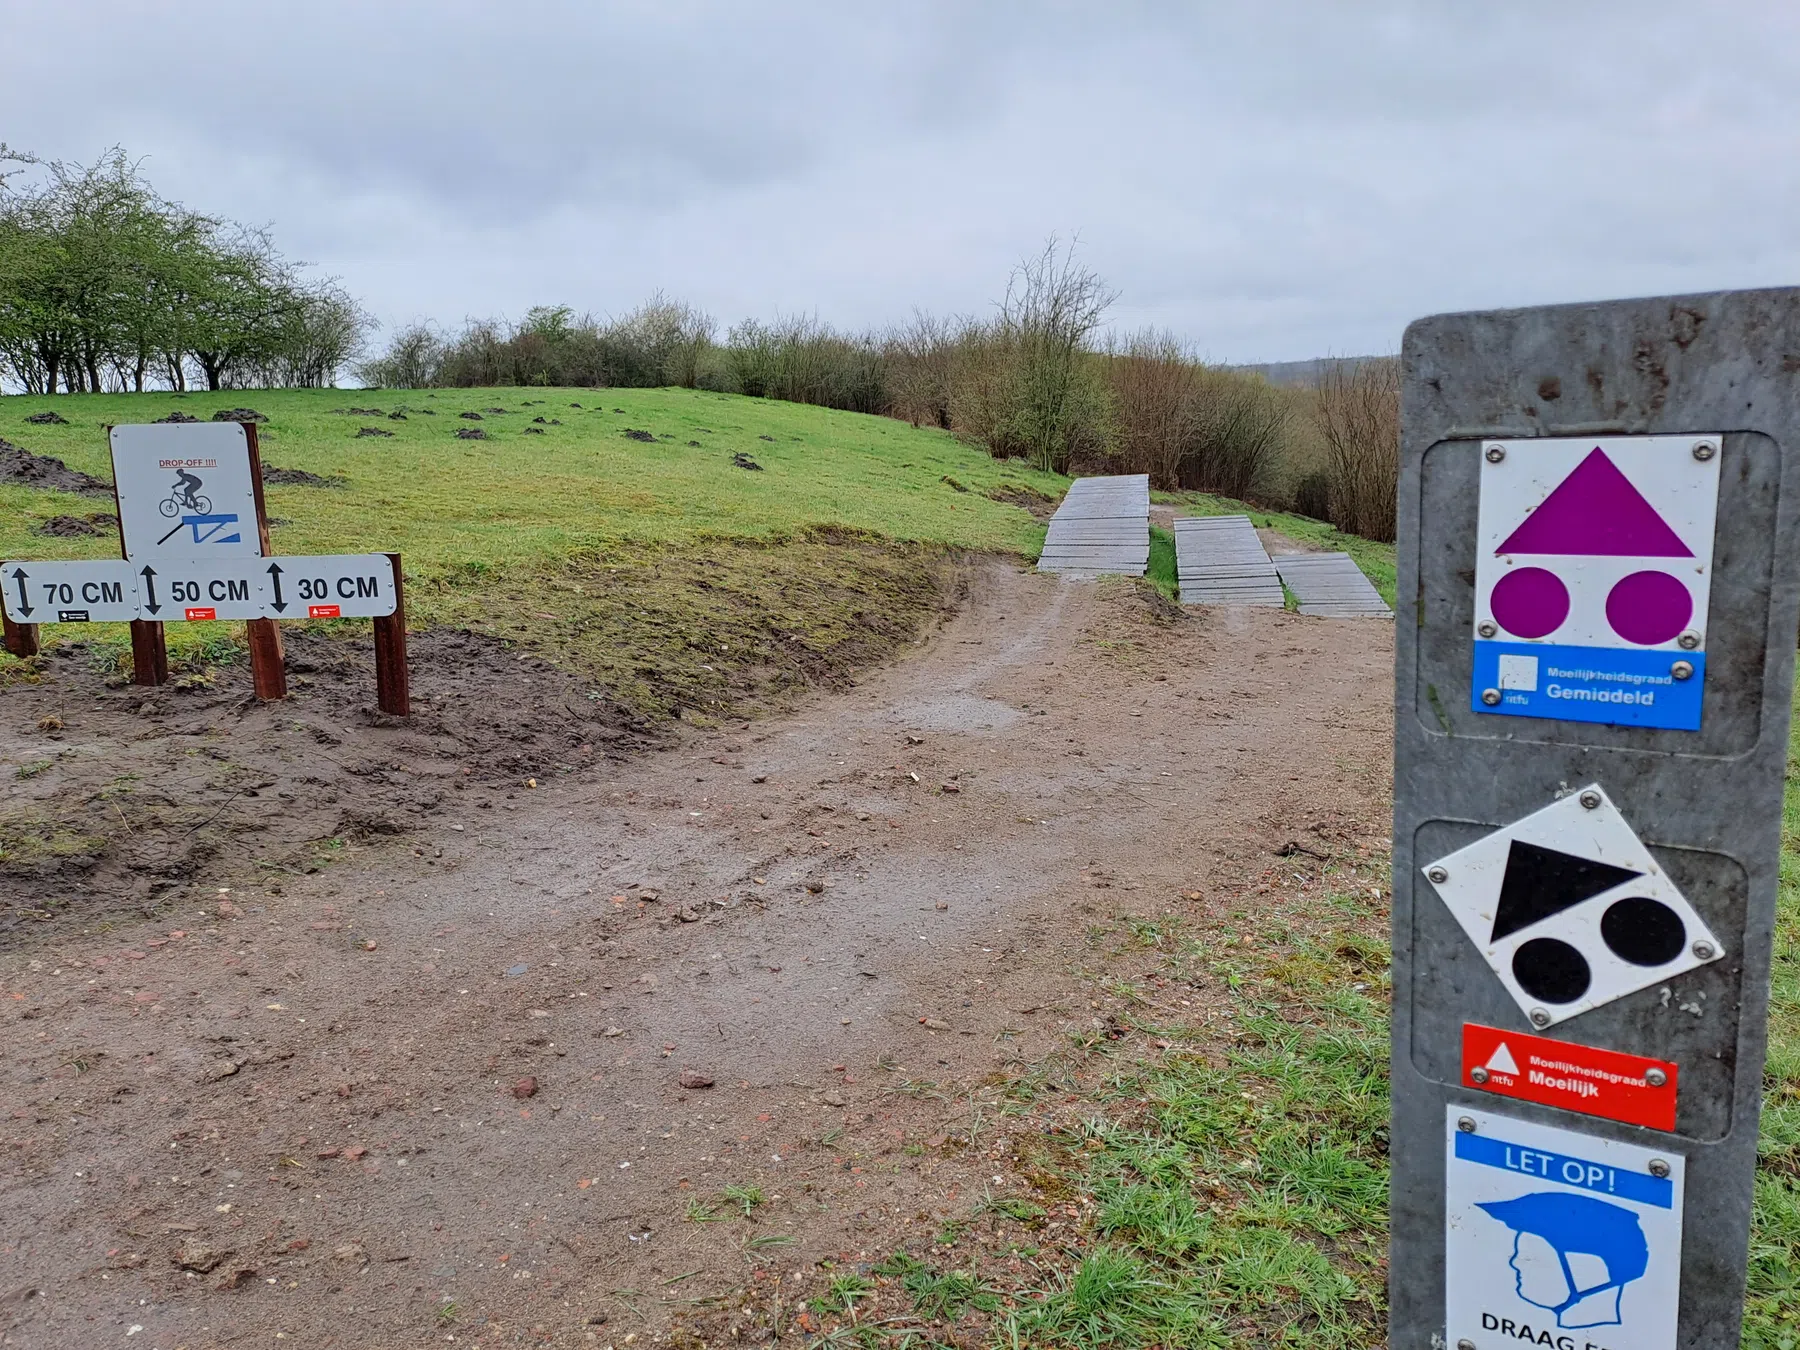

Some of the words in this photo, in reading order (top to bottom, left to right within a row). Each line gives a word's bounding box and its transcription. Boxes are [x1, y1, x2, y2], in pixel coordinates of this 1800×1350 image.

[159, 459, 203, 468] DROP-OFF
[43, 583, 74, 604] 70
[82, 582, 123, 604] CM
[172, 581, 200, 602] 50
[208, 580, 249, 602] CM
[298, 578, 328, 600] 30
[337, 576, 379, 599] CM
[1547, 684, 1654, 706] Gemiddeld
[1492, 1074, 1514, 1087] ntfu
[1529, 1070, 1600, 1098] Moeilijk
[1505, 1147, 1554, 1176] LET
[1562, 1161, 1615, 1192] OP!
[1482, 1313, 1574, 1350] DRAAG
